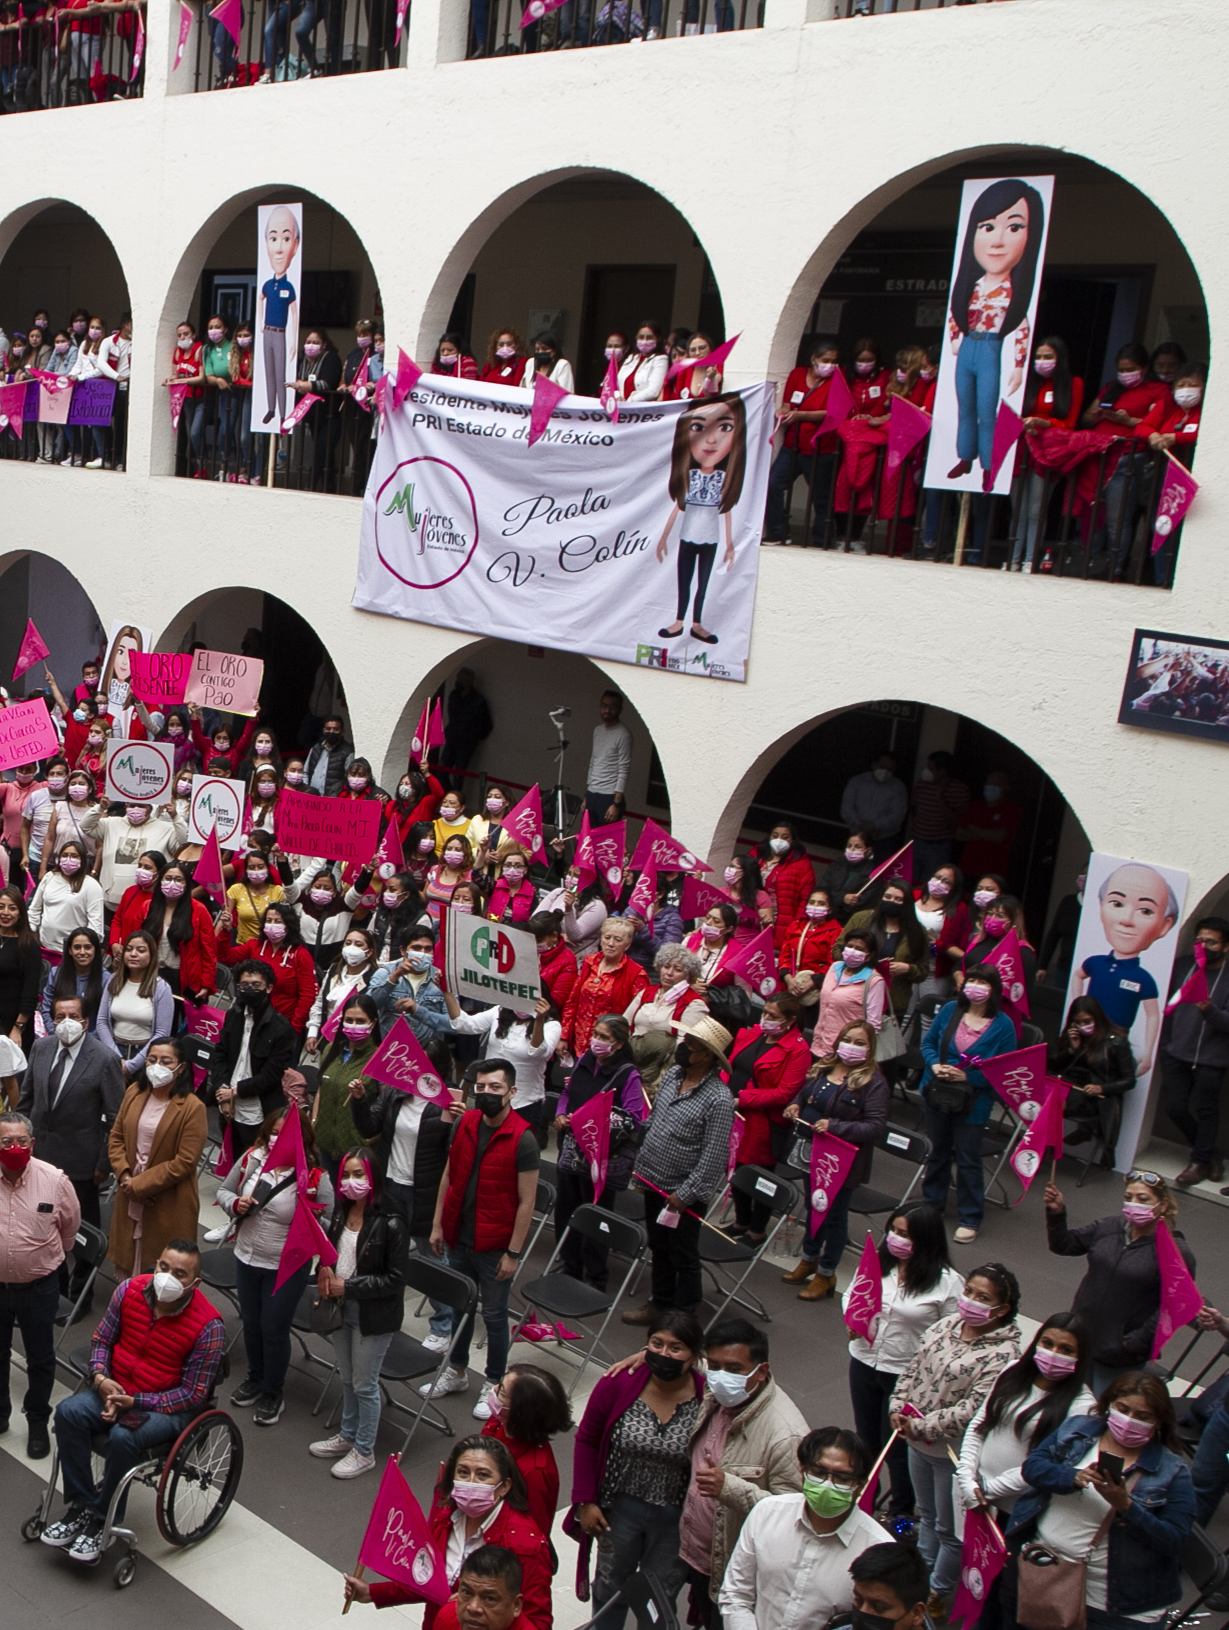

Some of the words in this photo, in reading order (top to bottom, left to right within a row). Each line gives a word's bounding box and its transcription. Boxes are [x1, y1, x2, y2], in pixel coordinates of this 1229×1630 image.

[412, 413, 443, 430] PRI
[446, 417, 507, 439] Estado
[541, 428, 615, 447] México
[502, 487, 612, 537] Paola
[486, 551, 546, 587] V.
[558, 530, 651, 573] Colín
[149, 653, 183, 681] ORO
[197, 651, 211, 671] EL
[220, 655, 247, 678] ORO
[636, 643, 668, 668] PRI
[200, 673, 236, 688] CONTIGO
[203, 685, 234, 706] Pao
[116, 755, 156, 777] Mujeres
[198, 794, 229, 817] Mujeres
[286, 793, 332, 812] APOYANDO
[339, 802, 346, 813] A
[349, 804, 362, 814] LA
[476, 937, 508, 964] PRI
[460, 967, 539, 1001] JILOTEPEC
